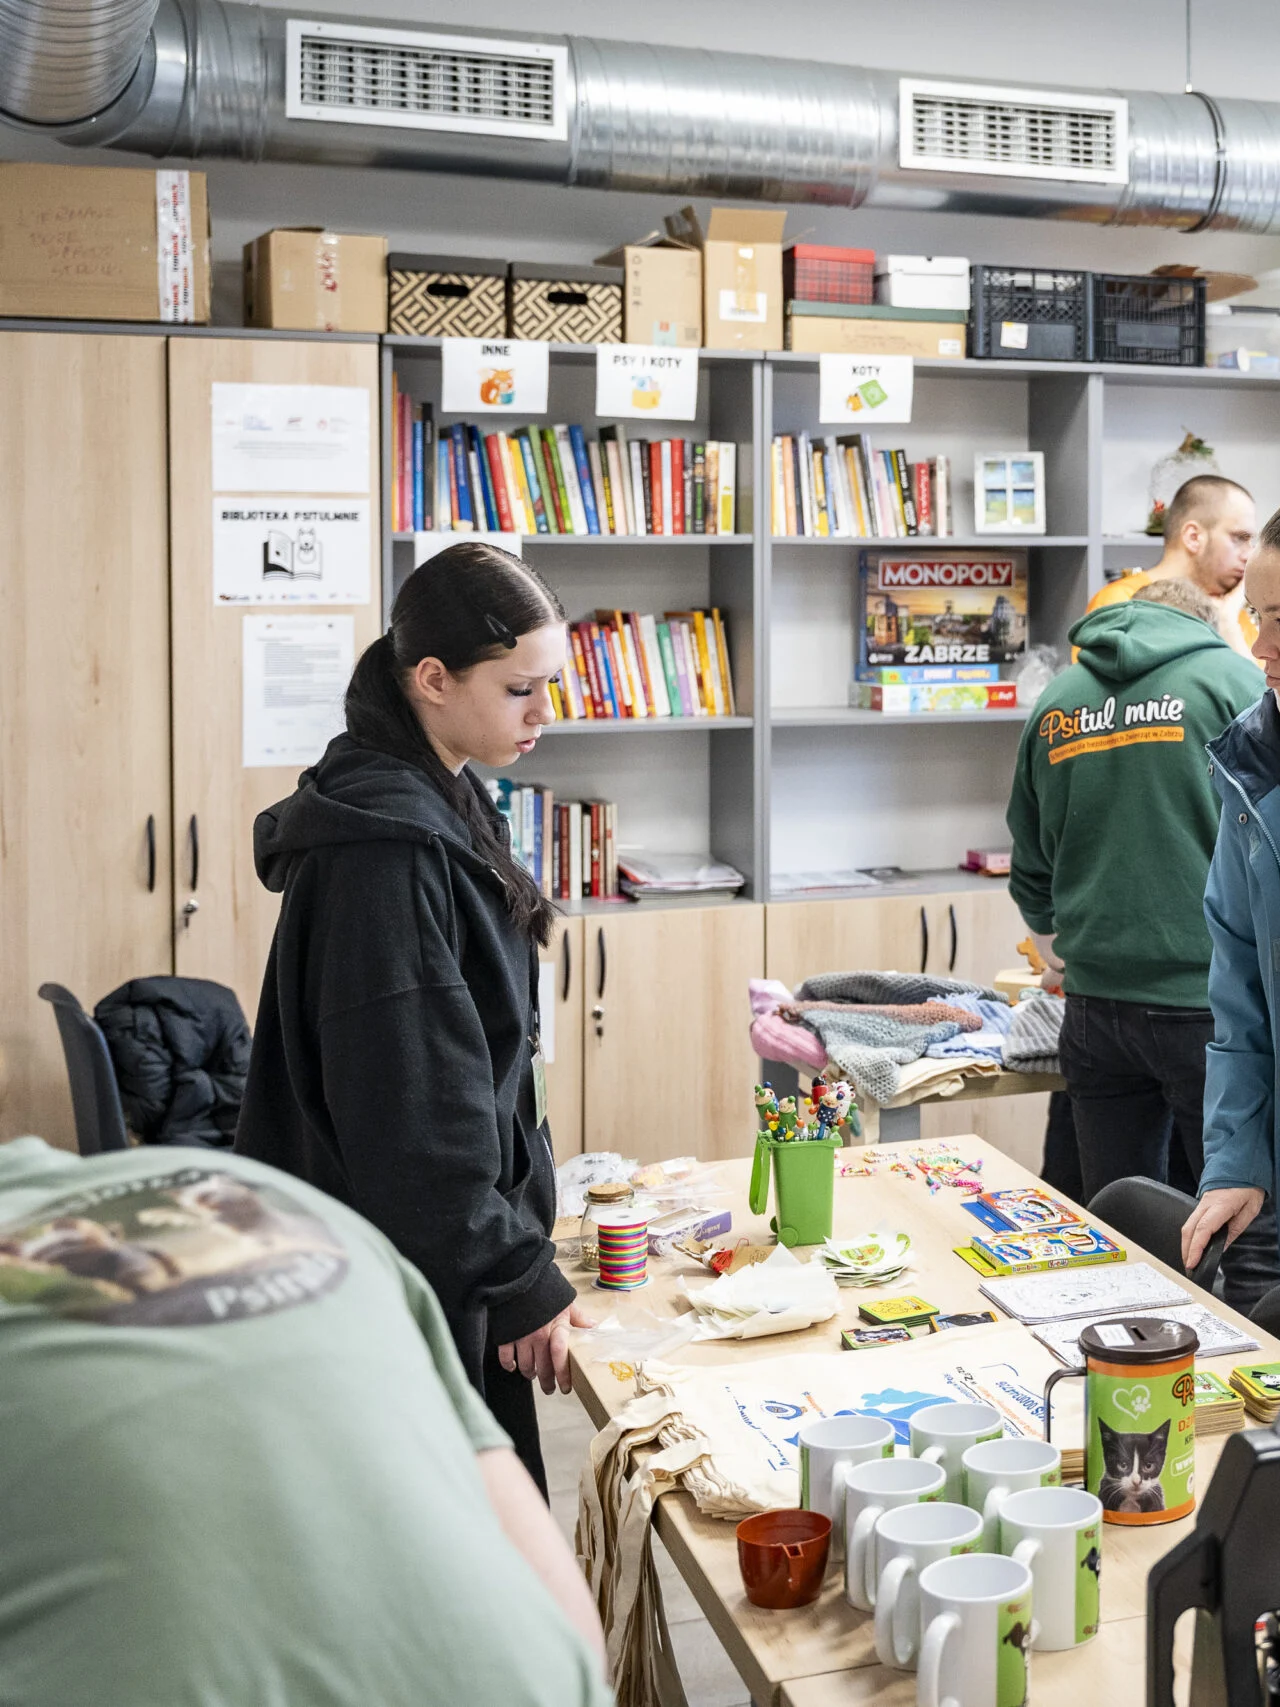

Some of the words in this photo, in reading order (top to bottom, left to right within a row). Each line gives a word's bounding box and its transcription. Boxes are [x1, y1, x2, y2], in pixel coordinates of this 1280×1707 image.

[481, 344, 512, 356] INNE
[612, 354, 637, 366] PSY
[650, 355, 684, 369] KOTY
[851, 365, 882, 376] KOTY
[221, 510, 289, 521] BIBLIOTEKA
[883, 562, 1011, 587] MONOPOLY
[903, 643, 991, 663] ZABRZE
[1039, 696, 1117, 745] Psitul
[1123, 694, 1185, 726] mnie
